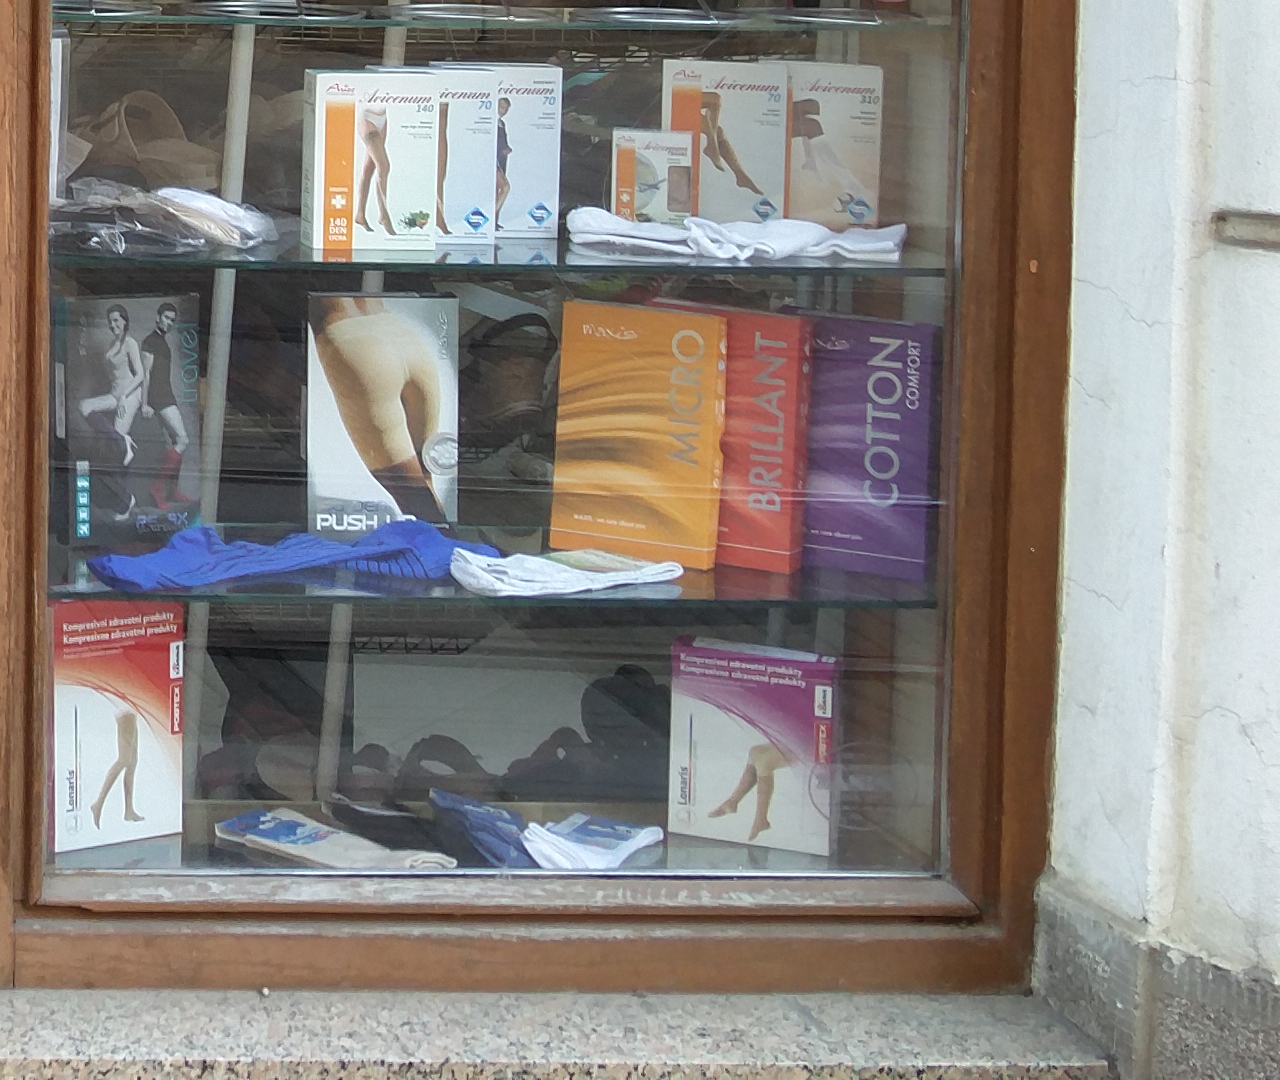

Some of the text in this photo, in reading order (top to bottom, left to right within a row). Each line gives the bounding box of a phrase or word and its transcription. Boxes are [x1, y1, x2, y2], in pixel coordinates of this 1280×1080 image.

[439, 87, 491, 100] icenum
[498, 80, 555, 96] vicenum
[479, 100, 492, 110] 70
[542, 96, 556, 106] 70
[767, 93, 781, 103] 70
[416, 104, 434, 113] 140
[329, 217, 347, 227] 140
[329, 226, 347, 235] DEN
[172, 323, 198, 403] travel
[905, 339, 922, 411] COMFORT
[666, 329, 706, 466] MICRO
[747, 331, 788, 513] BRILLANT
[863, 335, 905, 508] COTTON
[316, 512, 378, 531] PUSH
[143, 611, 175, 625] produkty
[146, 623, 178, 638] produkty
[766, 665, 803, 679] produkty
[769, 676, 807, 689] produkty
[65, 768, 75, 813] Lonaris
[677, 766, 688, 806] Lonaris
